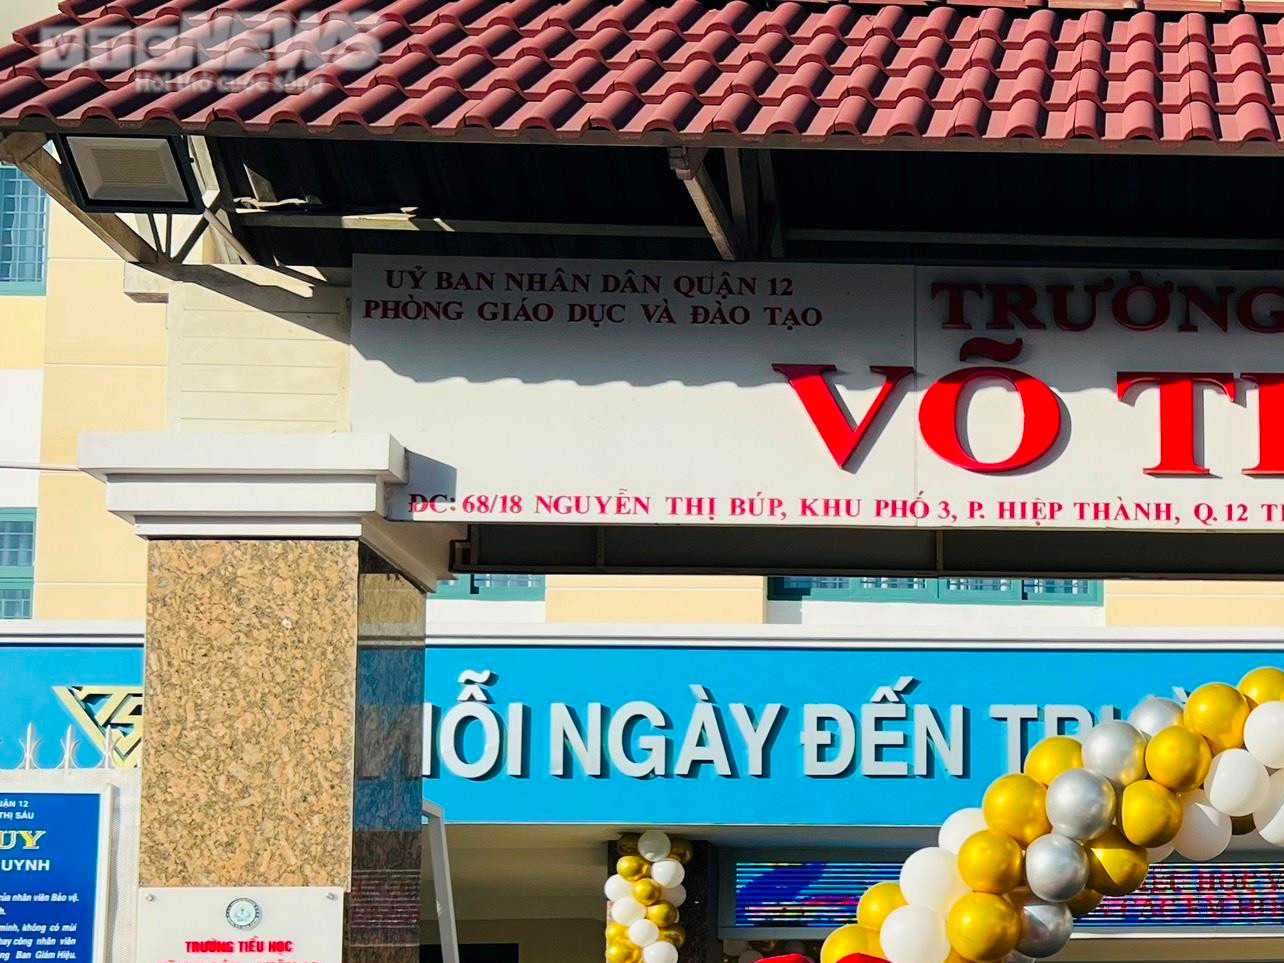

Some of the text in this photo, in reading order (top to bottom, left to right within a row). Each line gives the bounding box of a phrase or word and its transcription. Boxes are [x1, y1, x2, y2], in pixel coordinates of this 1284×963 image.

[436, 271, 496, 290] BAN
[504, 267, 591, 292] NHÂN
[602, 269, 662, 293] DÂN
[674, 271, 757, 299] QUẬN
[768, 277, 794, 295] 12
[363, 294, 822, 331] PHÒNG GIÁO DỤC VÀ ĐÀO TẠO
[772, 336, 1063, 473] VÕ
[408, 493, 456, 513] ĐC:
[461, 494, 522, 514] 68/18
[534, 487, 650, 515] NGUYỄN
[665, 496, 717, 521] THỊ
[728, 491, 788, 520] BÚP,
[799, 496, 862, 518] KHU
[874, 490, 930, 519] PHỐ
[937, 501, 957, 523] 3,
[967, 501, 986, 519] P.
[998, 496, 1063, 526] HIỆP
[1073, 496, 1180, 524] THÀNH,
[422, 669, 523, 779] ỖI
[550, 684, 788, 779] NGÀY
[800, 676, 967, 778] ĐẾN
[15, 810, 35, 820] SÁU
[18, 800, 29, 808] 12
[49, 923, 60, 932] có
[16, 950, 32, 959] Ban
[185, 935, 293, 955] TRƯỜNG TIỂU HỌC
